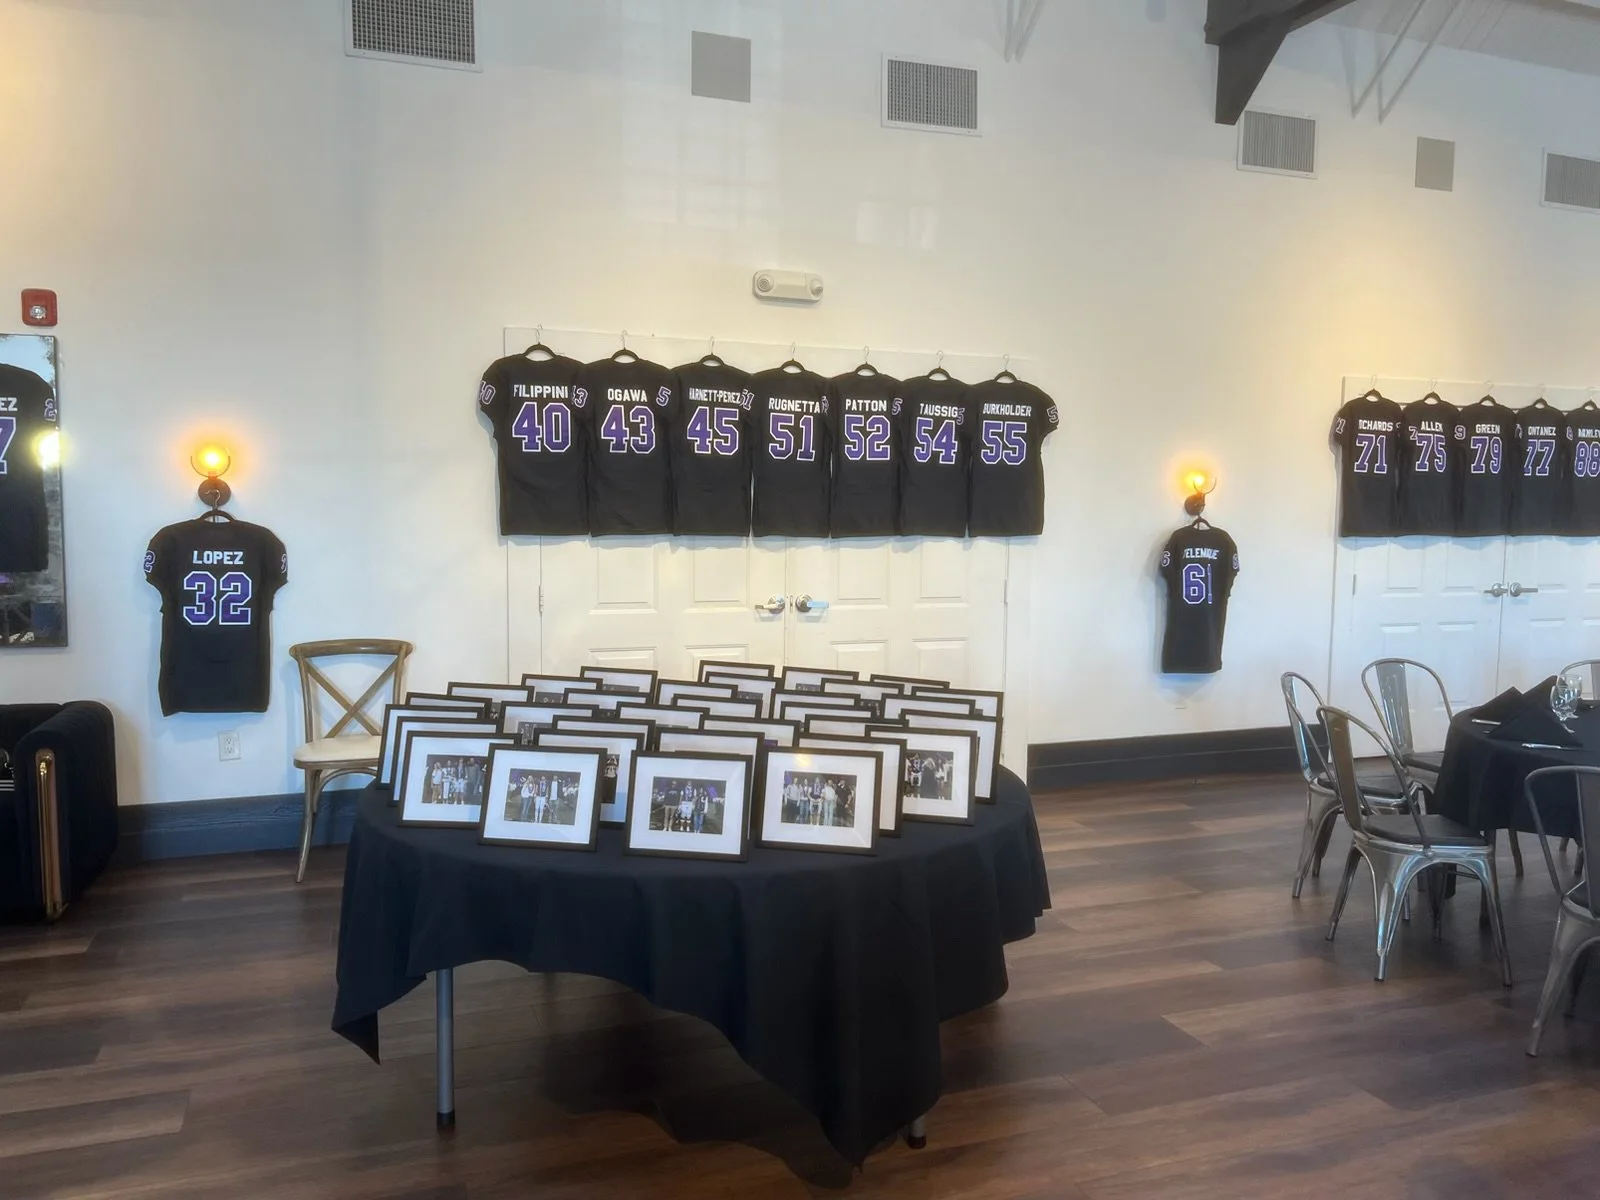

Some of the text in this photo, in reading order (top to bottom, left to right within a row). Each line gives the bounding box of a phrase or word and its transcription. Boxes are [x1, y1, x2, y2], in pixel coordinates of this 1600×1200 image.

[513, 384, 569, 398] FILIPPINI
[608, 388, 648, 402] OGAWA
[656, 386, 671, 407] 5
[769, 398, 820, 413] RUGNETTA
[846, 399, 887, 412] PATTON
[512, 402, 571, 453] 40
[920, 403, 958, 418] TAUSSIG
[1476, 424, 1500, 434] GREEN
[601, 405, 655, 454] 43
[687, 406, 739, 456] 45
[769, 412, 815, 461] 51
[845, 414, 890, 460] 52
[914, 417, 957, 464] 54
[981, 420, 1027, 465] 55
[1454, 425, 1466, 440] 9
[1354, 433, 1387, 474] 71
[1416, 433, 1447, 472] 75
[1471, 436, 1502, 473] 79
[1524, 439, 1555, 476] 77
[1574, 441, 1600, 477] 88
[192, 550, 244, 565] LOPEZ
[183, 571, 252, 625] 32
